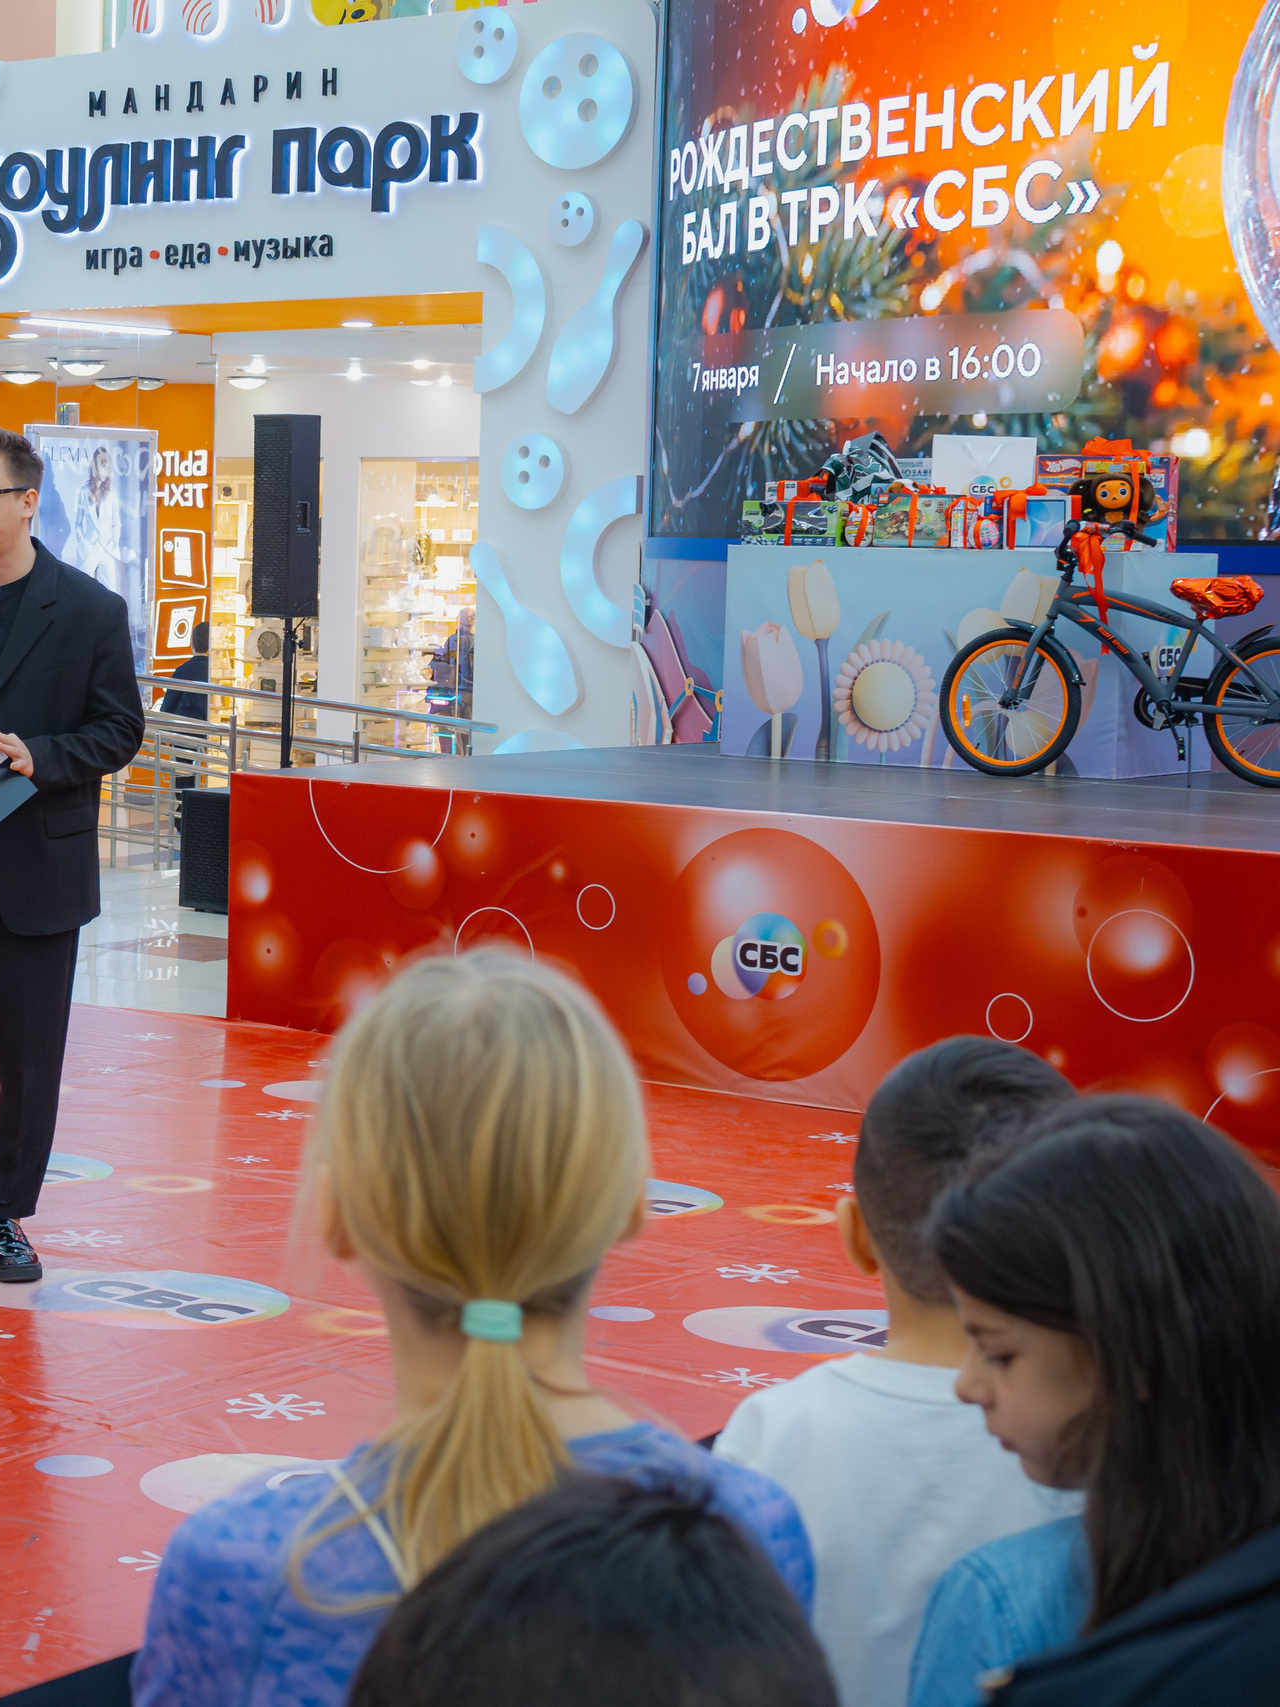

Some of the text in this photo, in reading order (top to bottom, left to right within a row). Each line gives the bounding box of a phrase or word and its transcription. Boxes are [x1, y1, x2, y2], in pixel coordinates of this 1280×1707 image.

[88, 66, 338, 118] МАНДАРИН
[669, 42, 1170, 200] РОЖДЕСТВЕНСКИЙ
[681, 159, 1102, 266] БАЛ В ТРК «СБС»
[85, 233, 334, 275] игра еда музыка
[692, 362, 760, 397] 7 января
[816, 342, 1042, 386] Начало в 16:00
[971, 485, 996, 495] СБС
[739, 942, 800, 973] СБС
[71, 1279, 257, 1323] СБС
